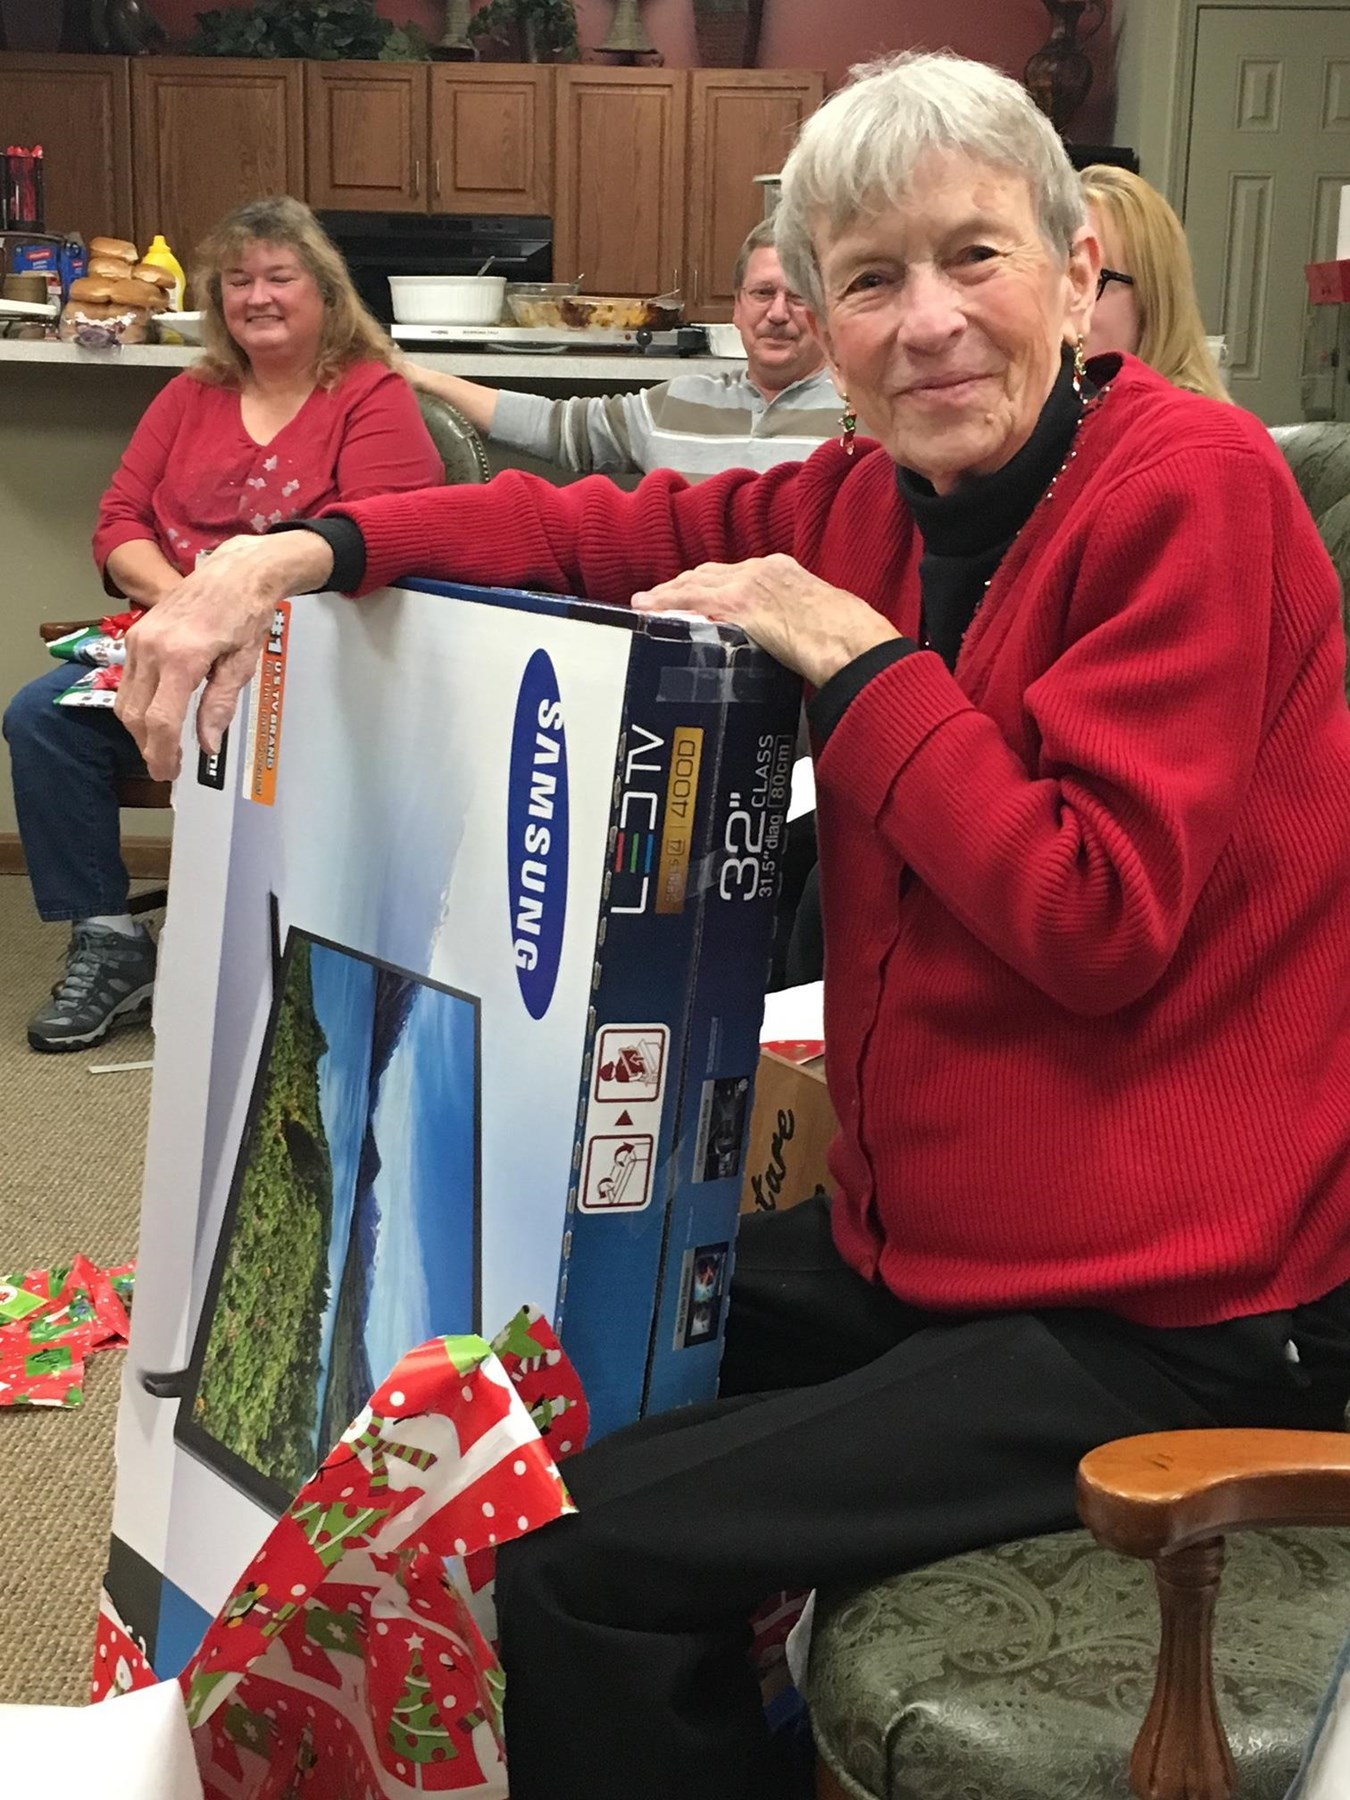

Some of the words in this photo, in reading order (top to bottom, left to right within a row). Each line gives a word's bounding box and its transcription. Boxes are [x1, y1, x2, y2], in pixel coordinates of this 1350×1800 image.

[751, 734, 774, 807] CLASS
[772, 744, 791, 799] 80cm
[514, 698, 565, 971] SAMSUNG
[752, 1109, 795, 1213] tare
